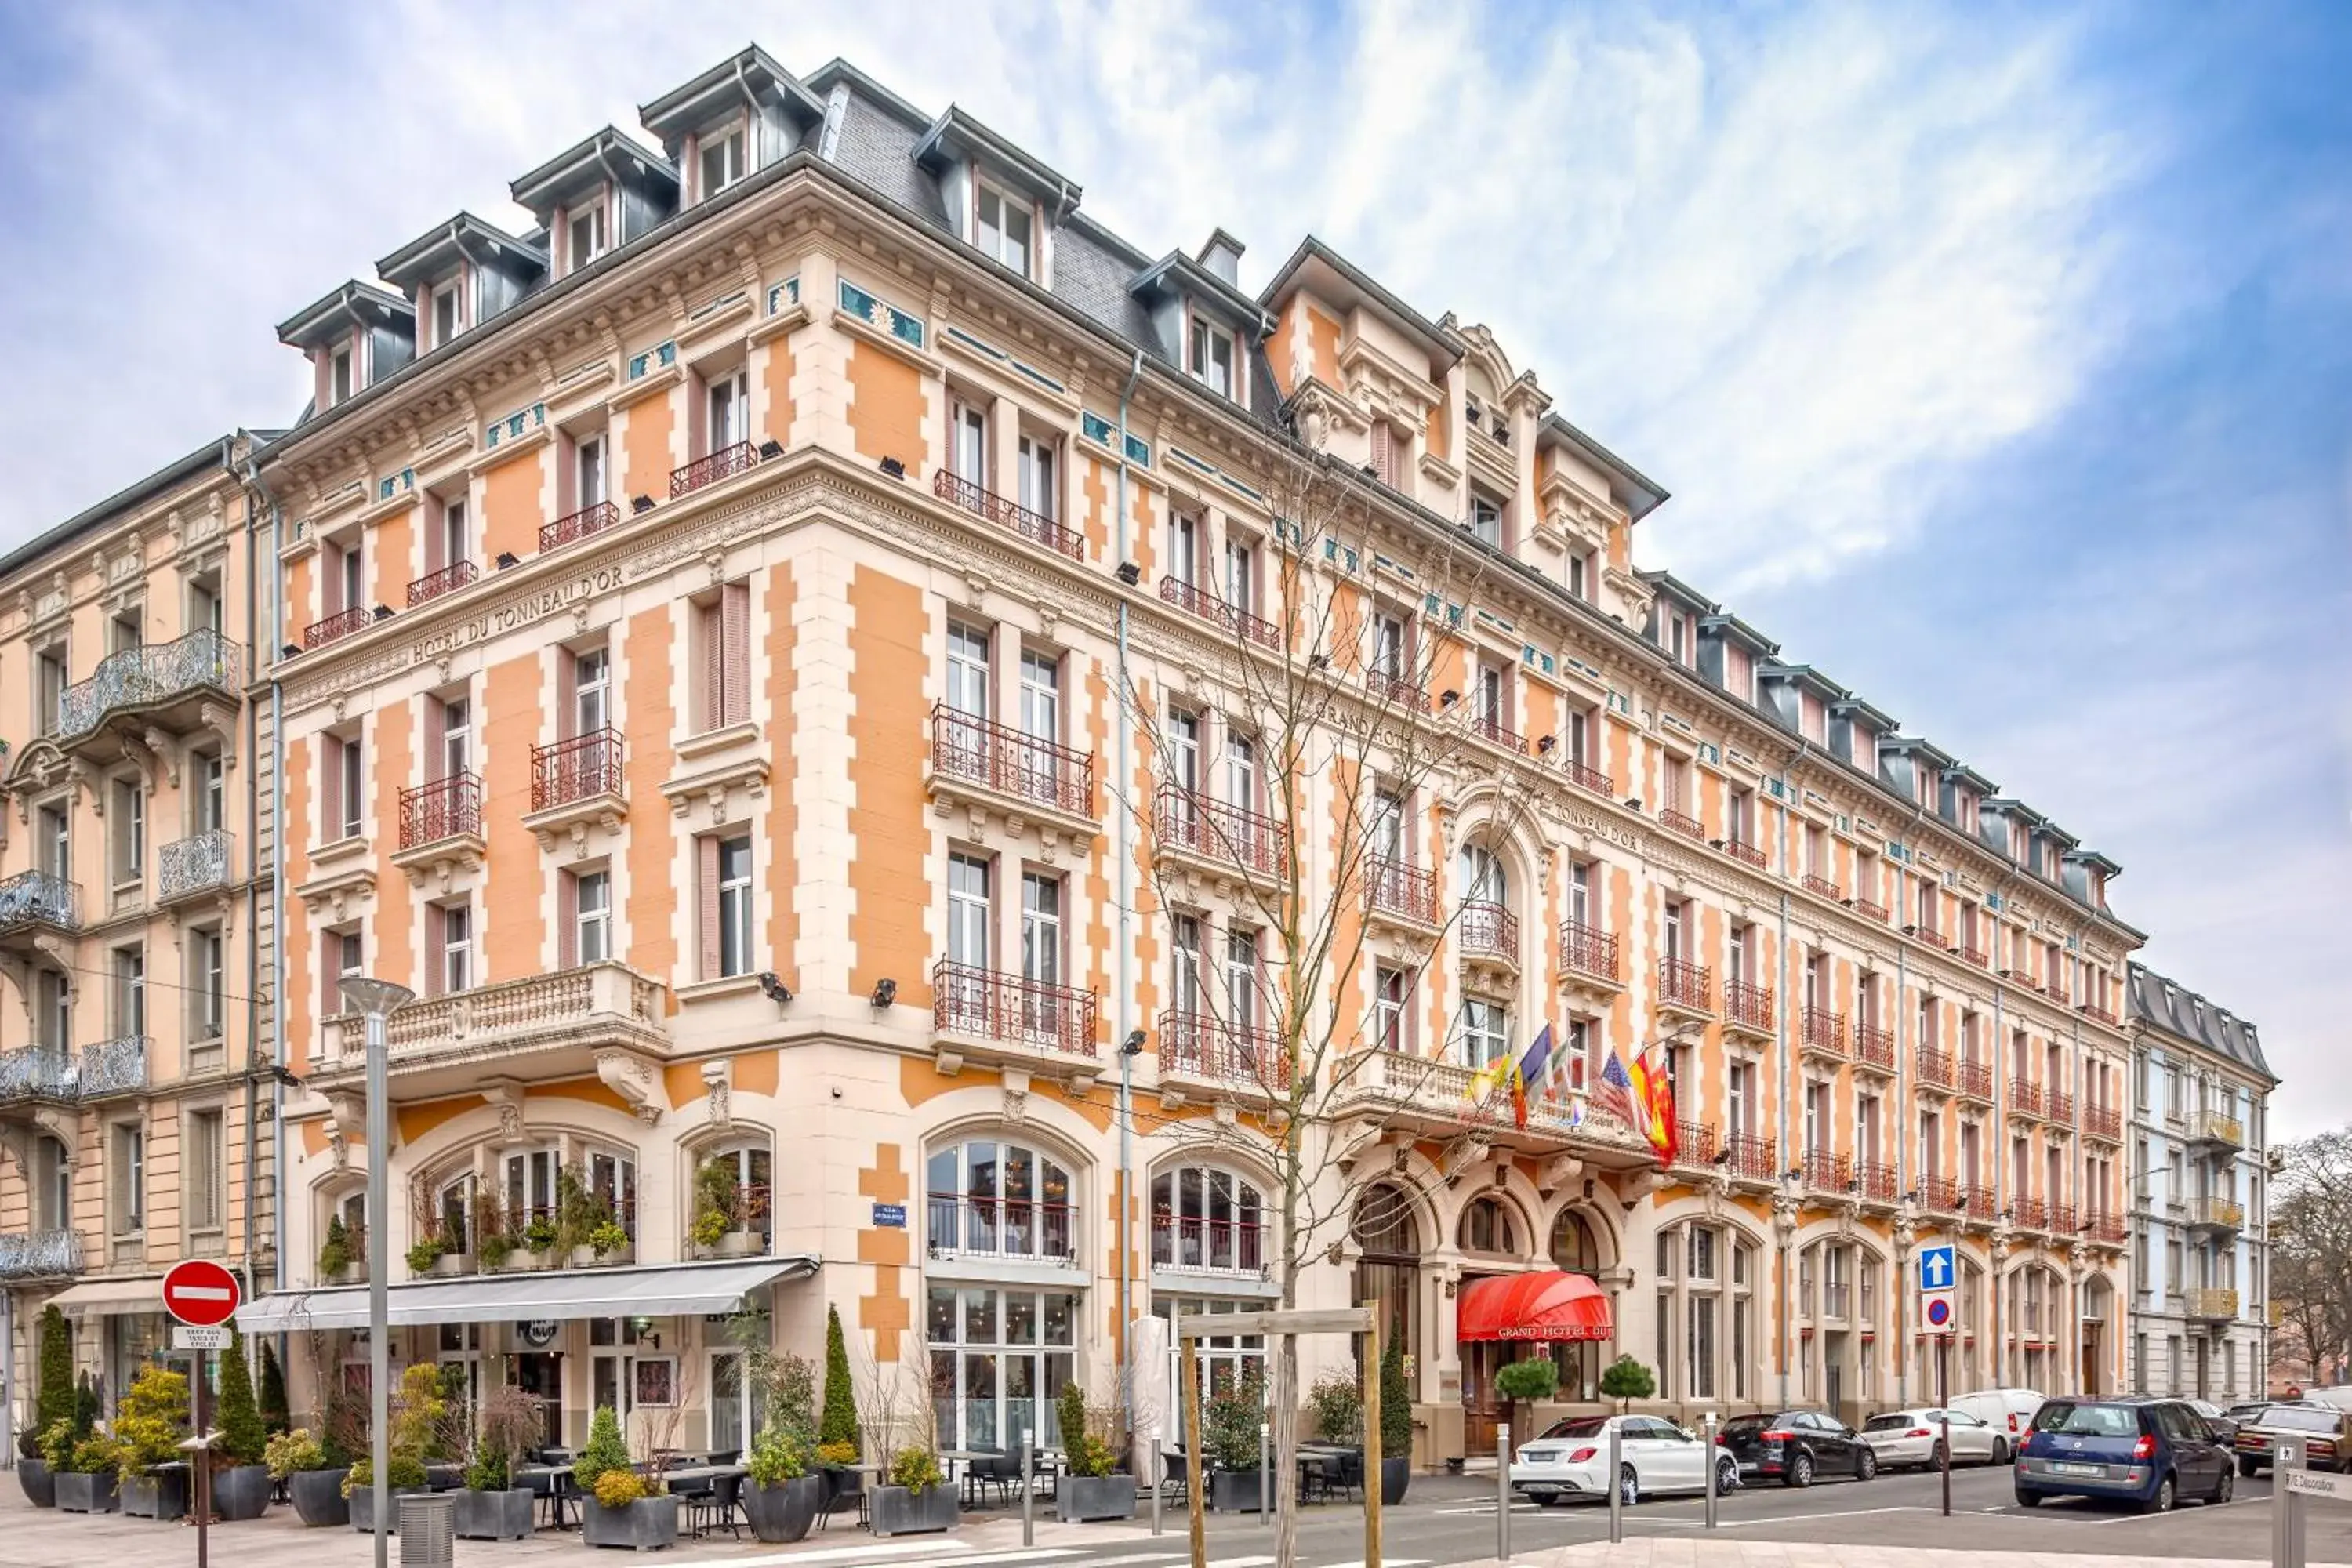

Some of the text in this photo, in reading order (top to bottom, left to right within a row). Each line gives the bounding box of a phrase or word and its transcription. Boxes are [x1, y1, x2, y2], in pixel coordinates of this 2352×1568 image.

[414, 567, 623, 663] HOTEL DU TONNEAU D'OR
[1315, 702, 1369, 735] GRAND
[1373, 727, 1418, 755] HOT
[1555, 804, 1637, 850] TONNEAU D'OR
[1498, 1327, 1537, 1338] GRAND
[1543, 1326, 1586, 1337] HOTEL
